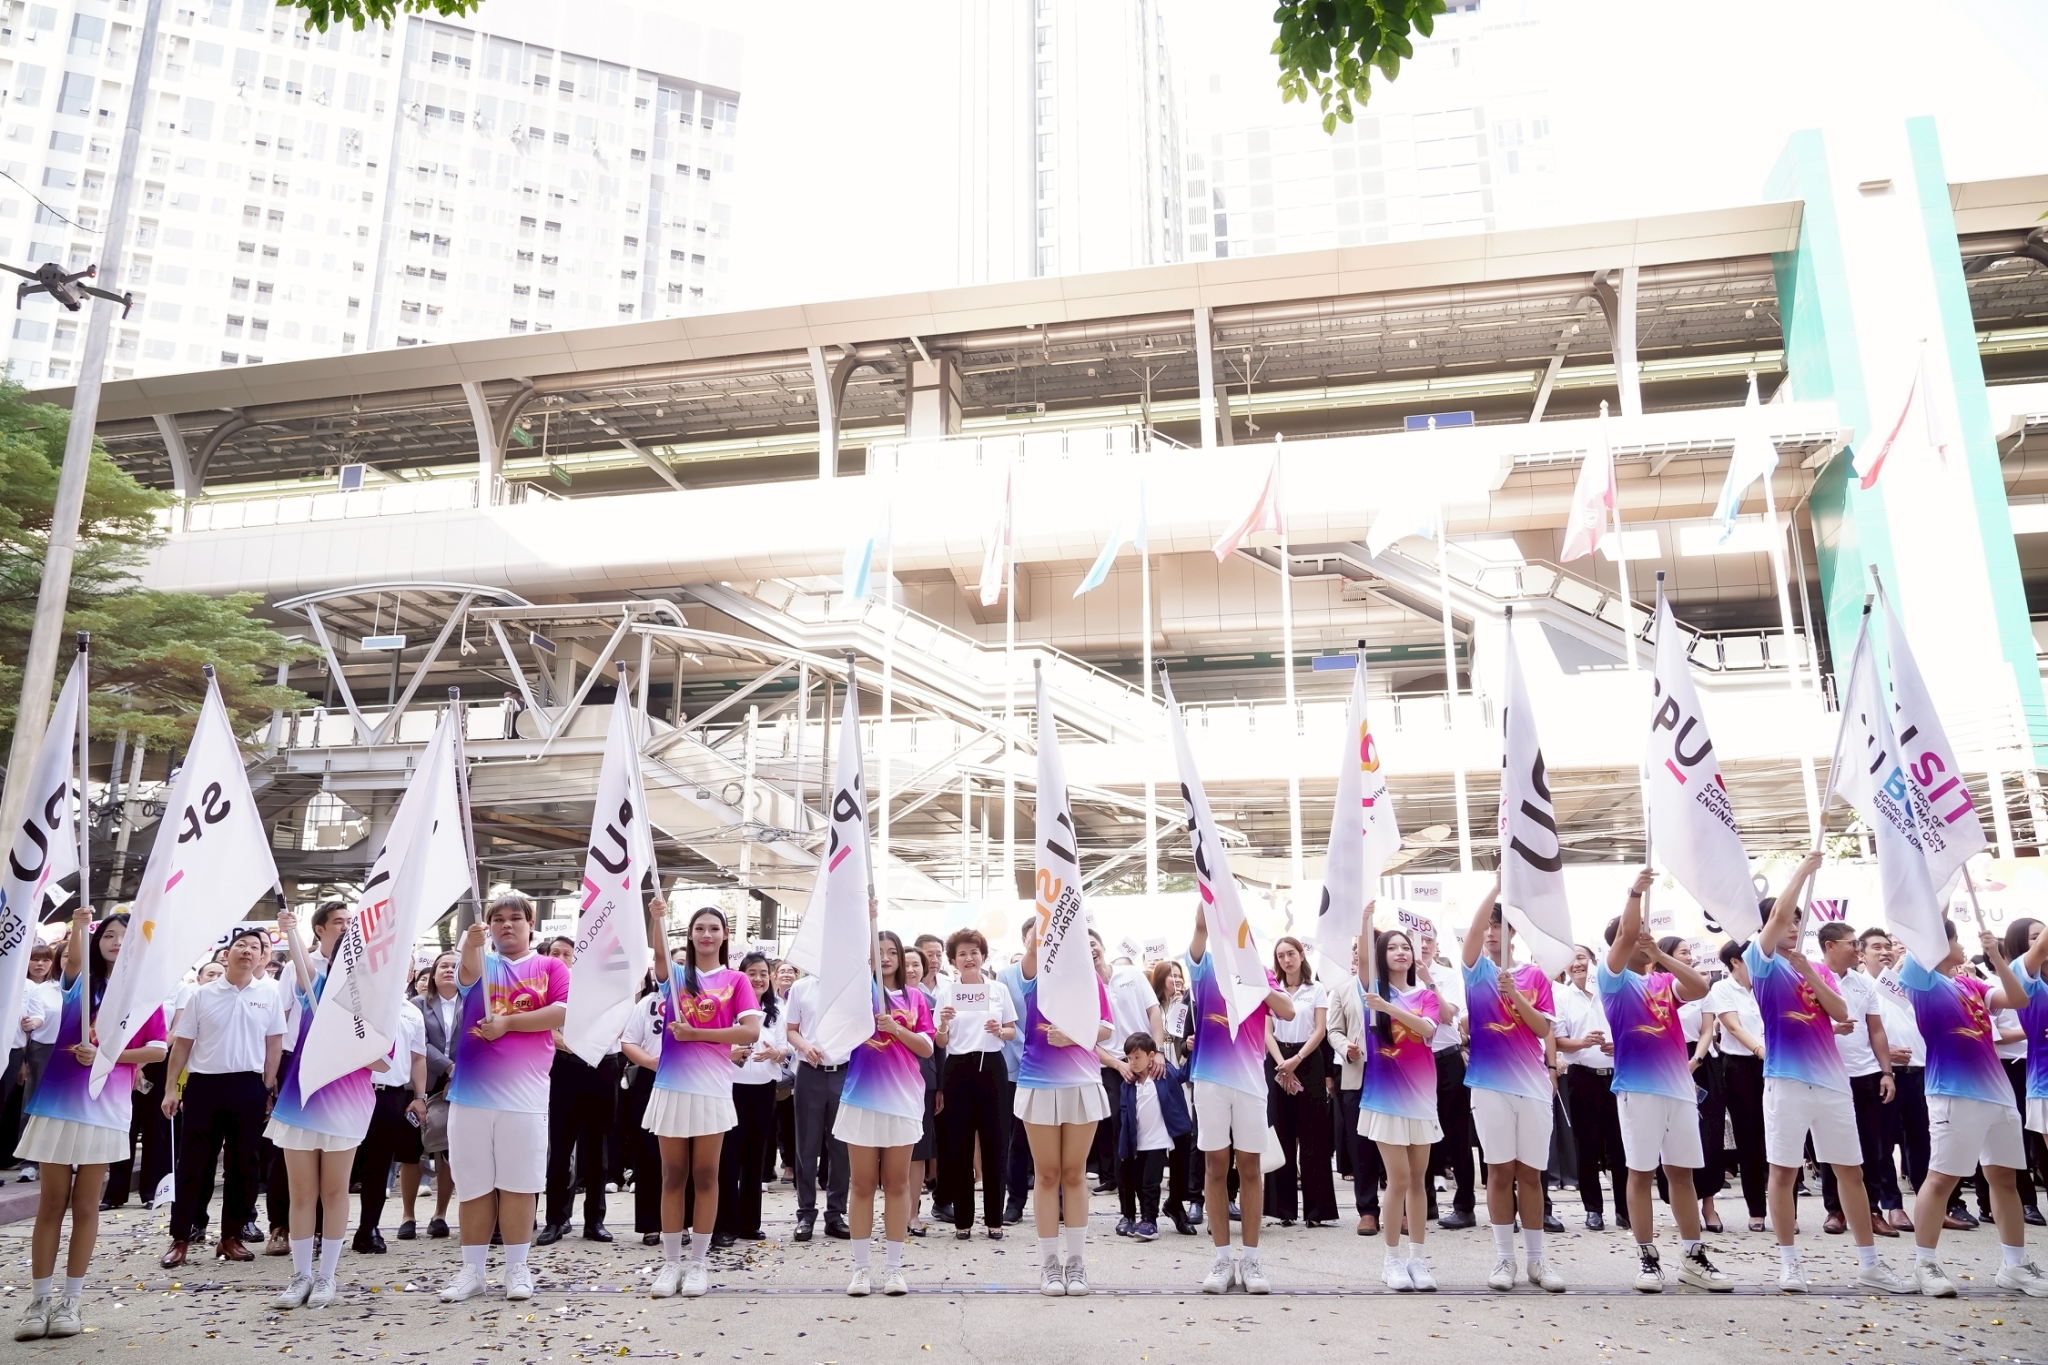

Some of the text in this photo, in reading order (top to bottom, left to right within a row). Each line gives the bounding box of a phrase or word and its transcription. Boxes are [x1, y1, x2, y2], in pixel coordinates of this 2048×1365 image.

[1653, 677, 1713, 767] PU
[1910, 752, 1974, 825] SIT
[1695, 791, 1743, 836] ENGINEE
[1872, 796, 1907, 835] BUSINESS
[1905, 833, 1926, 857] ADM
[1876, 789, 1917, 830] SCHOOL OF
[1932, 814, 1945, 829] OF
[351, 915, 364, 962] SCHOOL
[1398, 910, 1418, 931] SPU
[515, 1000, 533, 1008] SPU
[956, 993, 974, 1003] SPU
[1880, 976, 1900, 996] SPU
